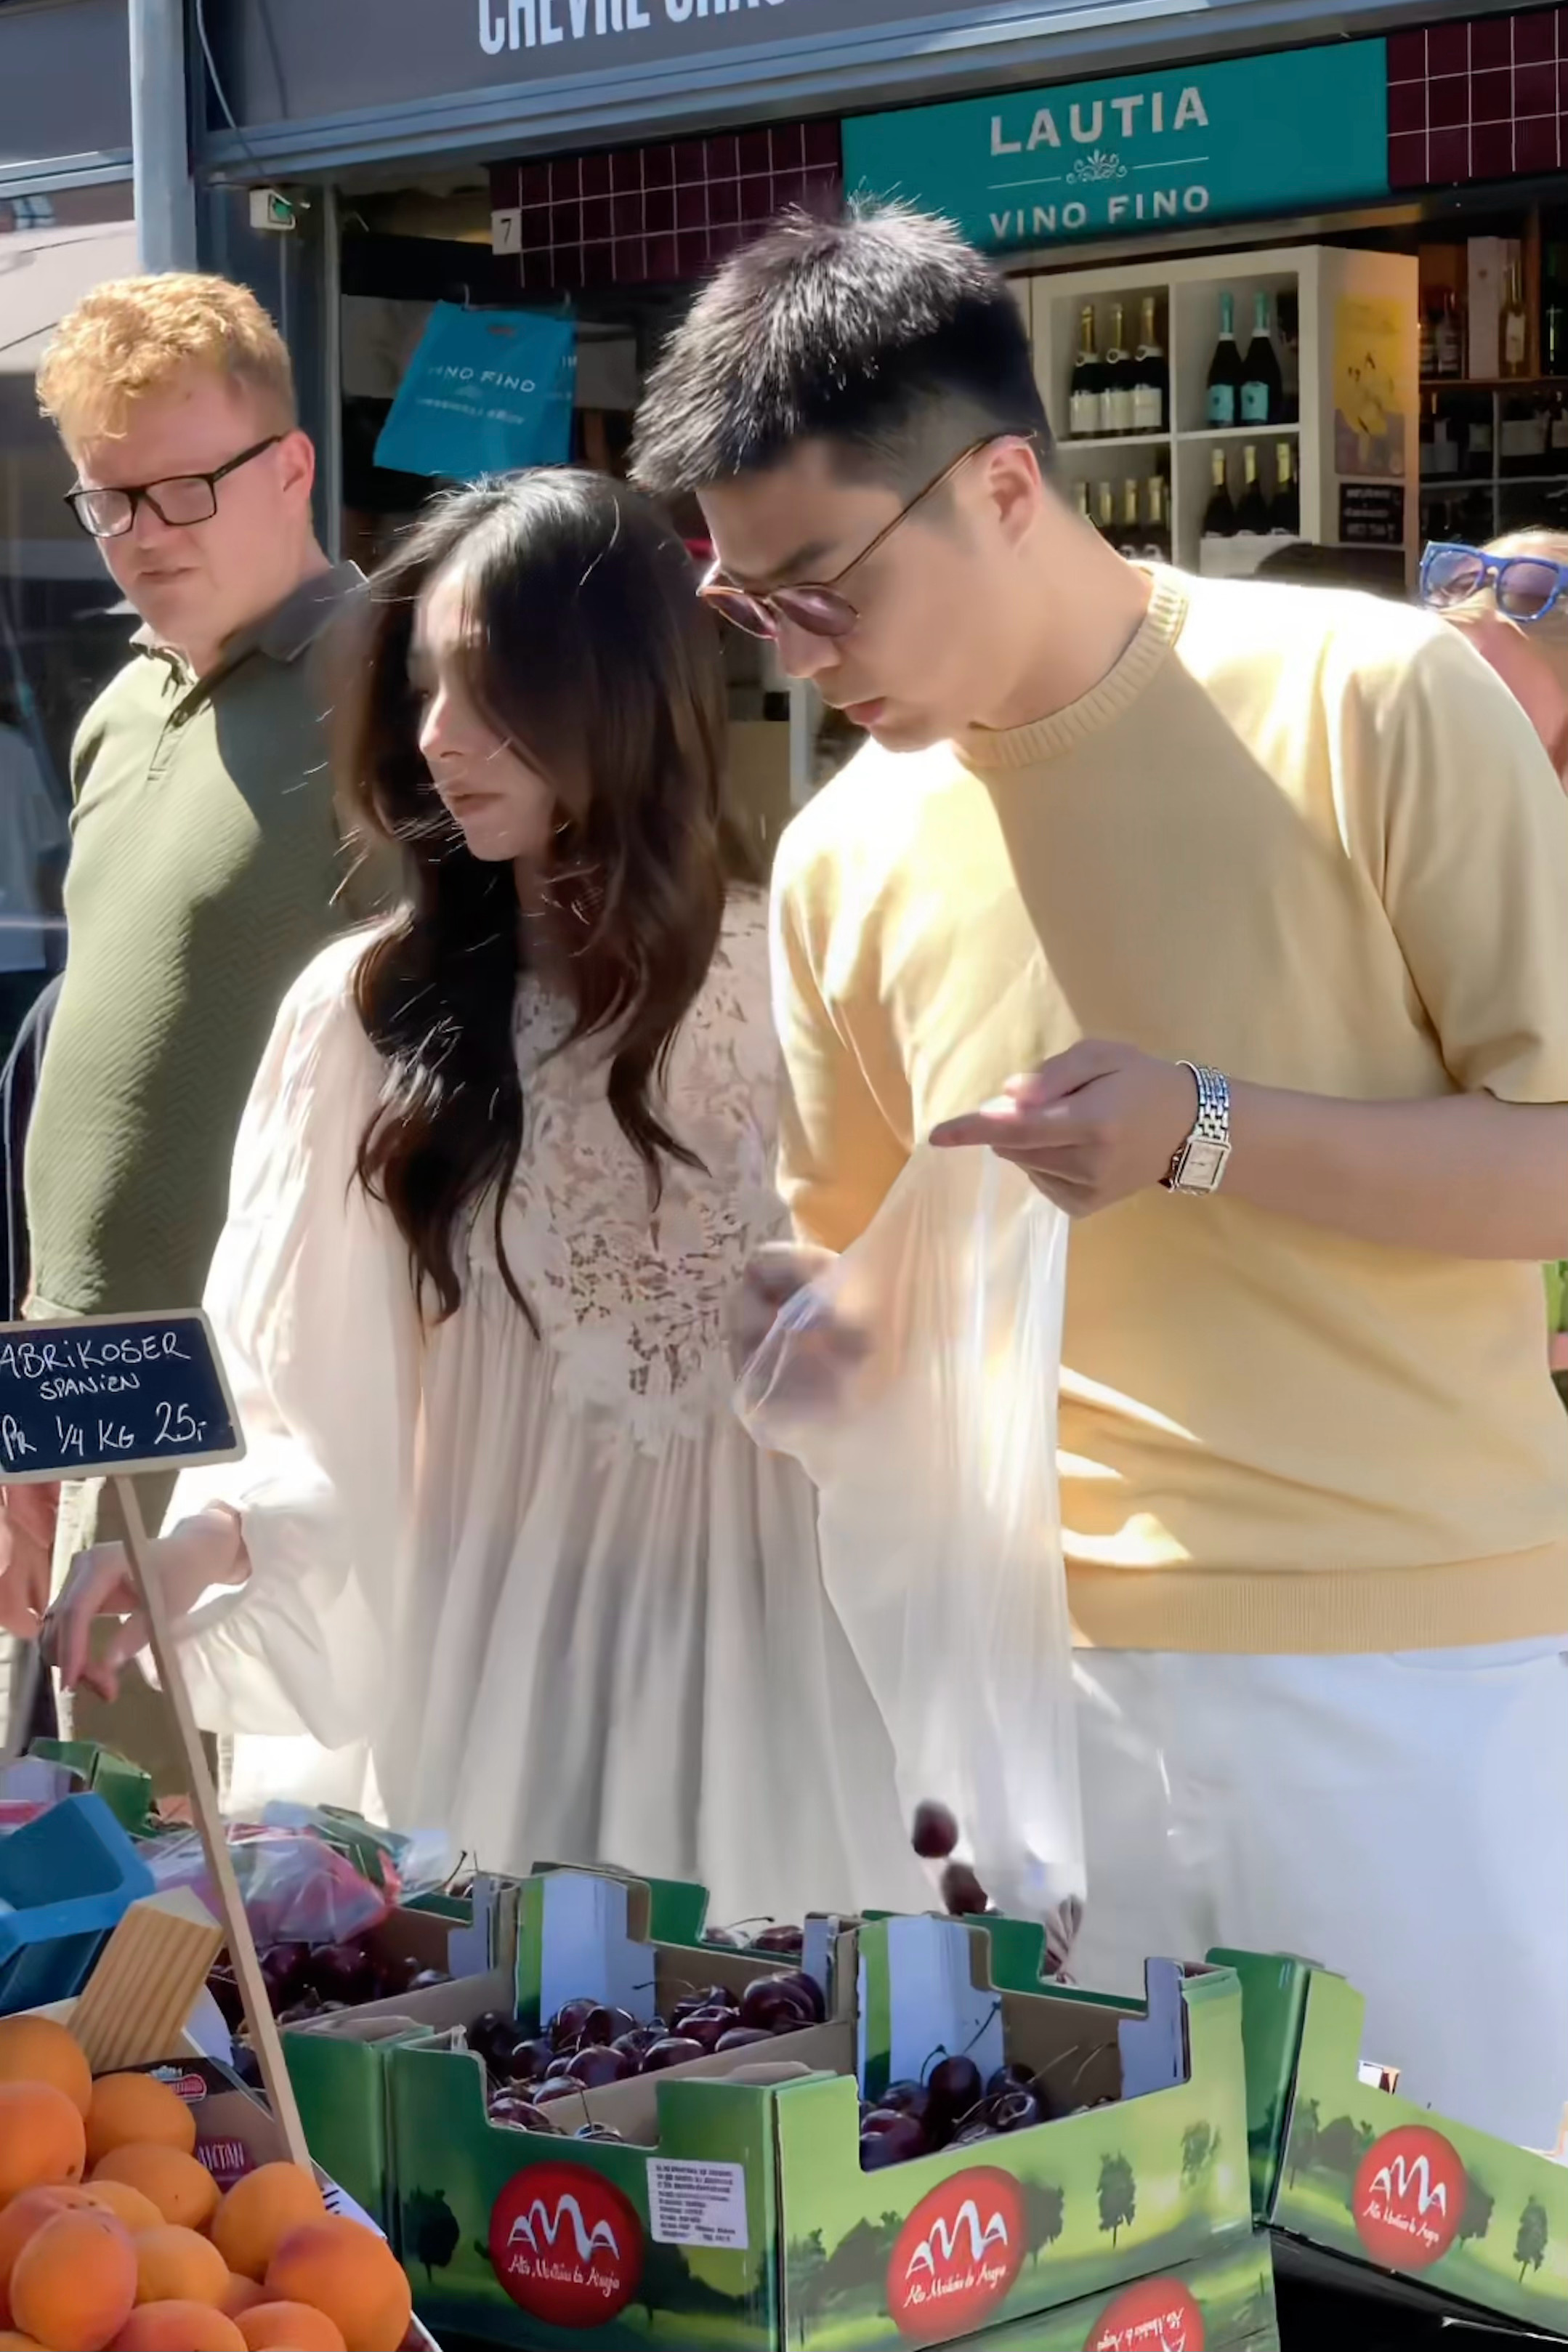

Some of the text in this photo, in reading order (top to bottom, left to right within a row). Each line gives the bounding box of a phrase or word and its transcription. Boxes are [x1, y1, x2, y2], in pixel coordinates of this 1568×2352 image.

[990, 86, 1210, 157] LAUTIA
[500, 218, 512, 245] 7
[989, 185, 1210, 239] VINO FINO
[480, 370, 536, 393] FINO
[55, 1415, 84, 1457] 1/4
